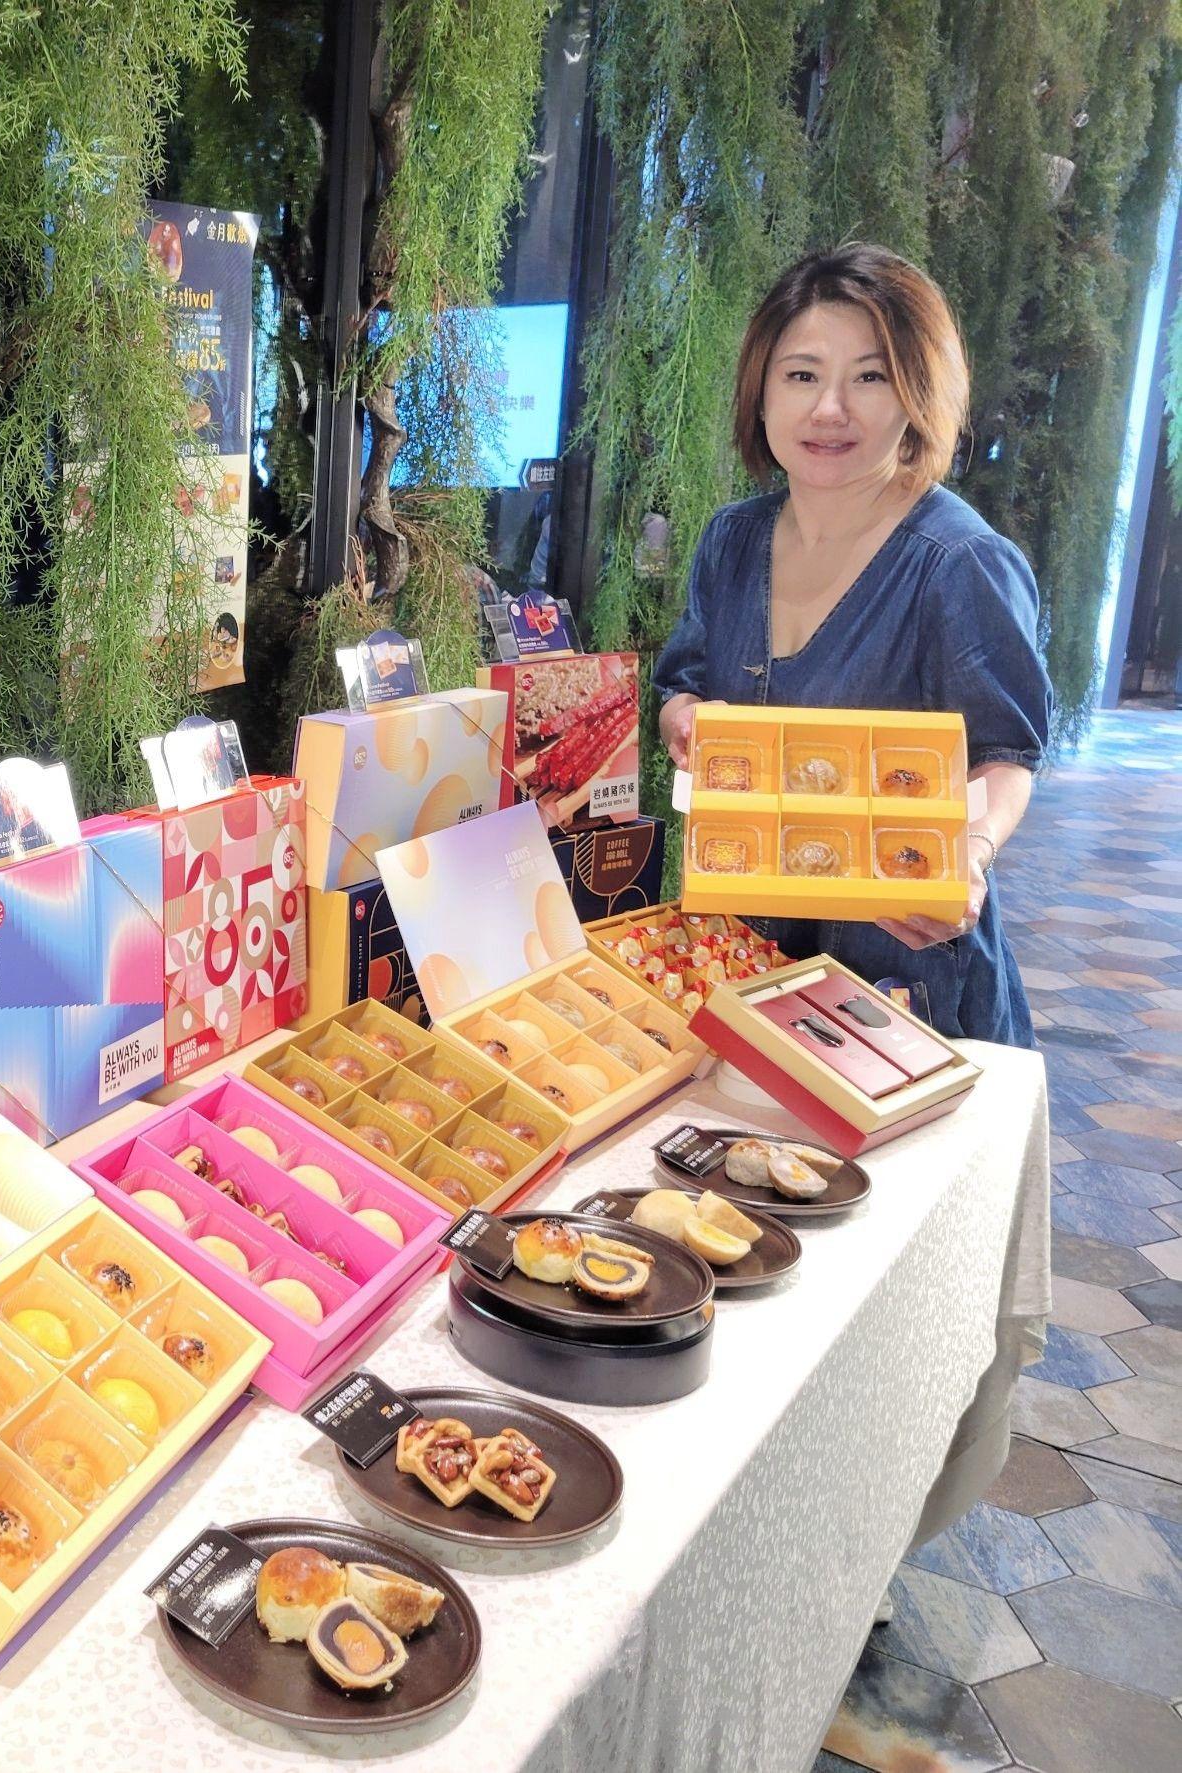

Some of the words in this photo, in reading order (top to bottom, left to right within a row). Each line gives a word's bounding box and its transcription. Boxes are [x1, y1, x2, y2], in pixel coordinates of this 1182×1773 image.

[459, 804, 483, 821] ALWAYS
[105, 1040, 140, 1069] ALWAYS
[173, 1037, 197, 1057] ALWAYS
[173, 1057, 182, 1070] BE
[182, 1047, 199, 1066] WITH
[198, 1041, 210, 1058] YOU
[104, 1065, 116, 1084] BE
[118, 1055, 140, 1077] WITH
[142, 1044, 159, 1065] YOU
